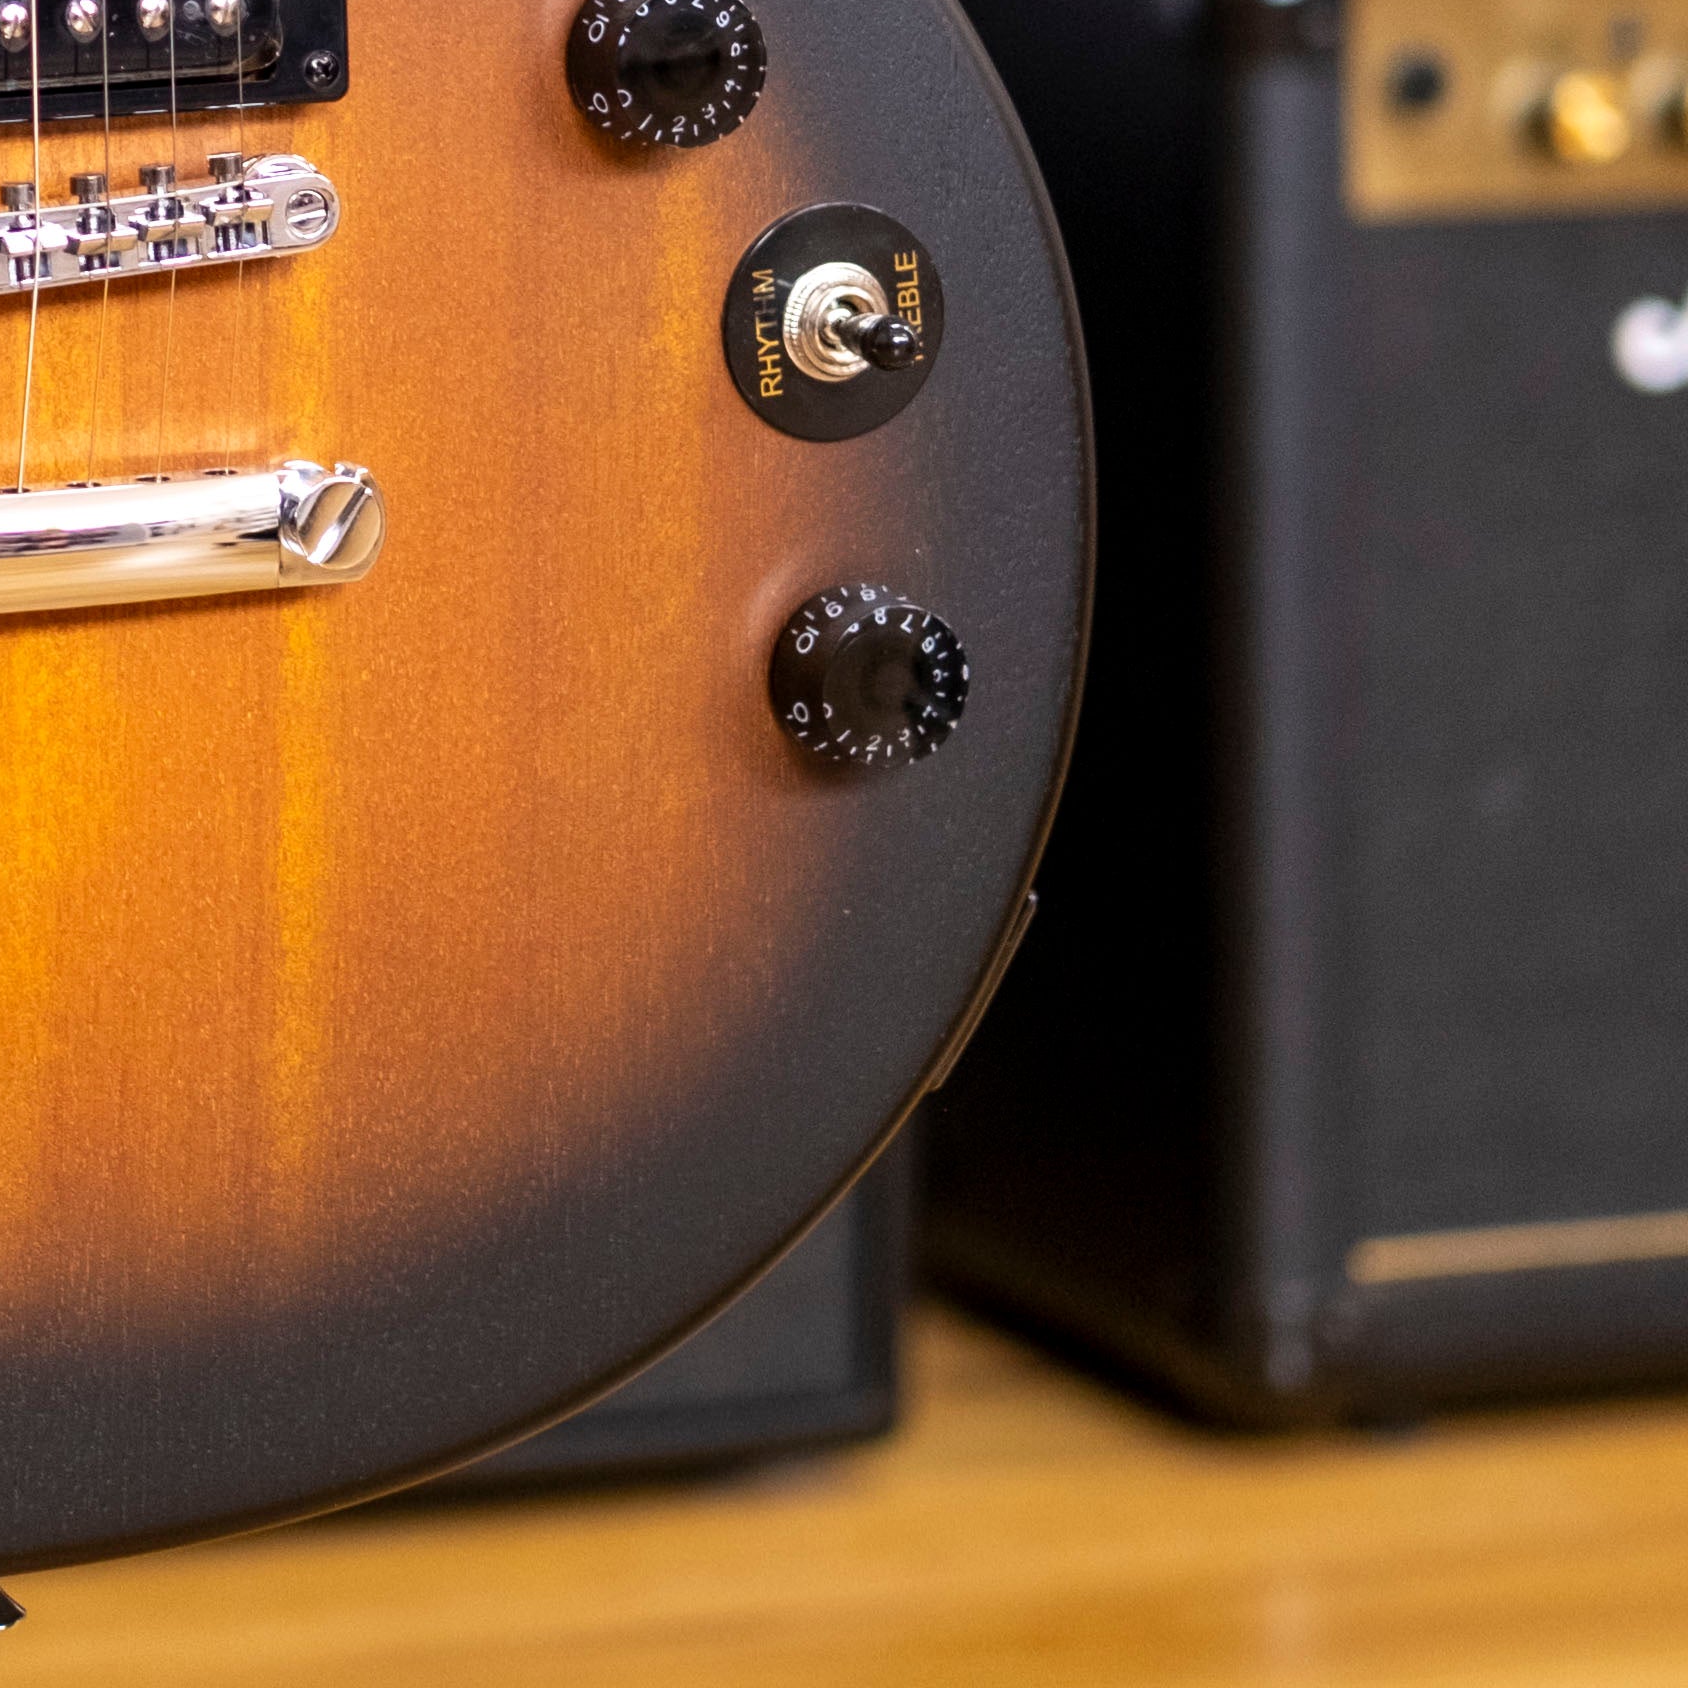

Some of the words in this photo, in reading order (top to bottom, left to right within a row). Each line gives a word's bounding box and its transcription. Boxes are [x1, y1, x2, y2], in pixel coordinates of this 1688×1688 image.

[671, 115, 686, 133] 2
[894, 250, 924, 362] EBLE
[866, 734, 882, 752] 2
